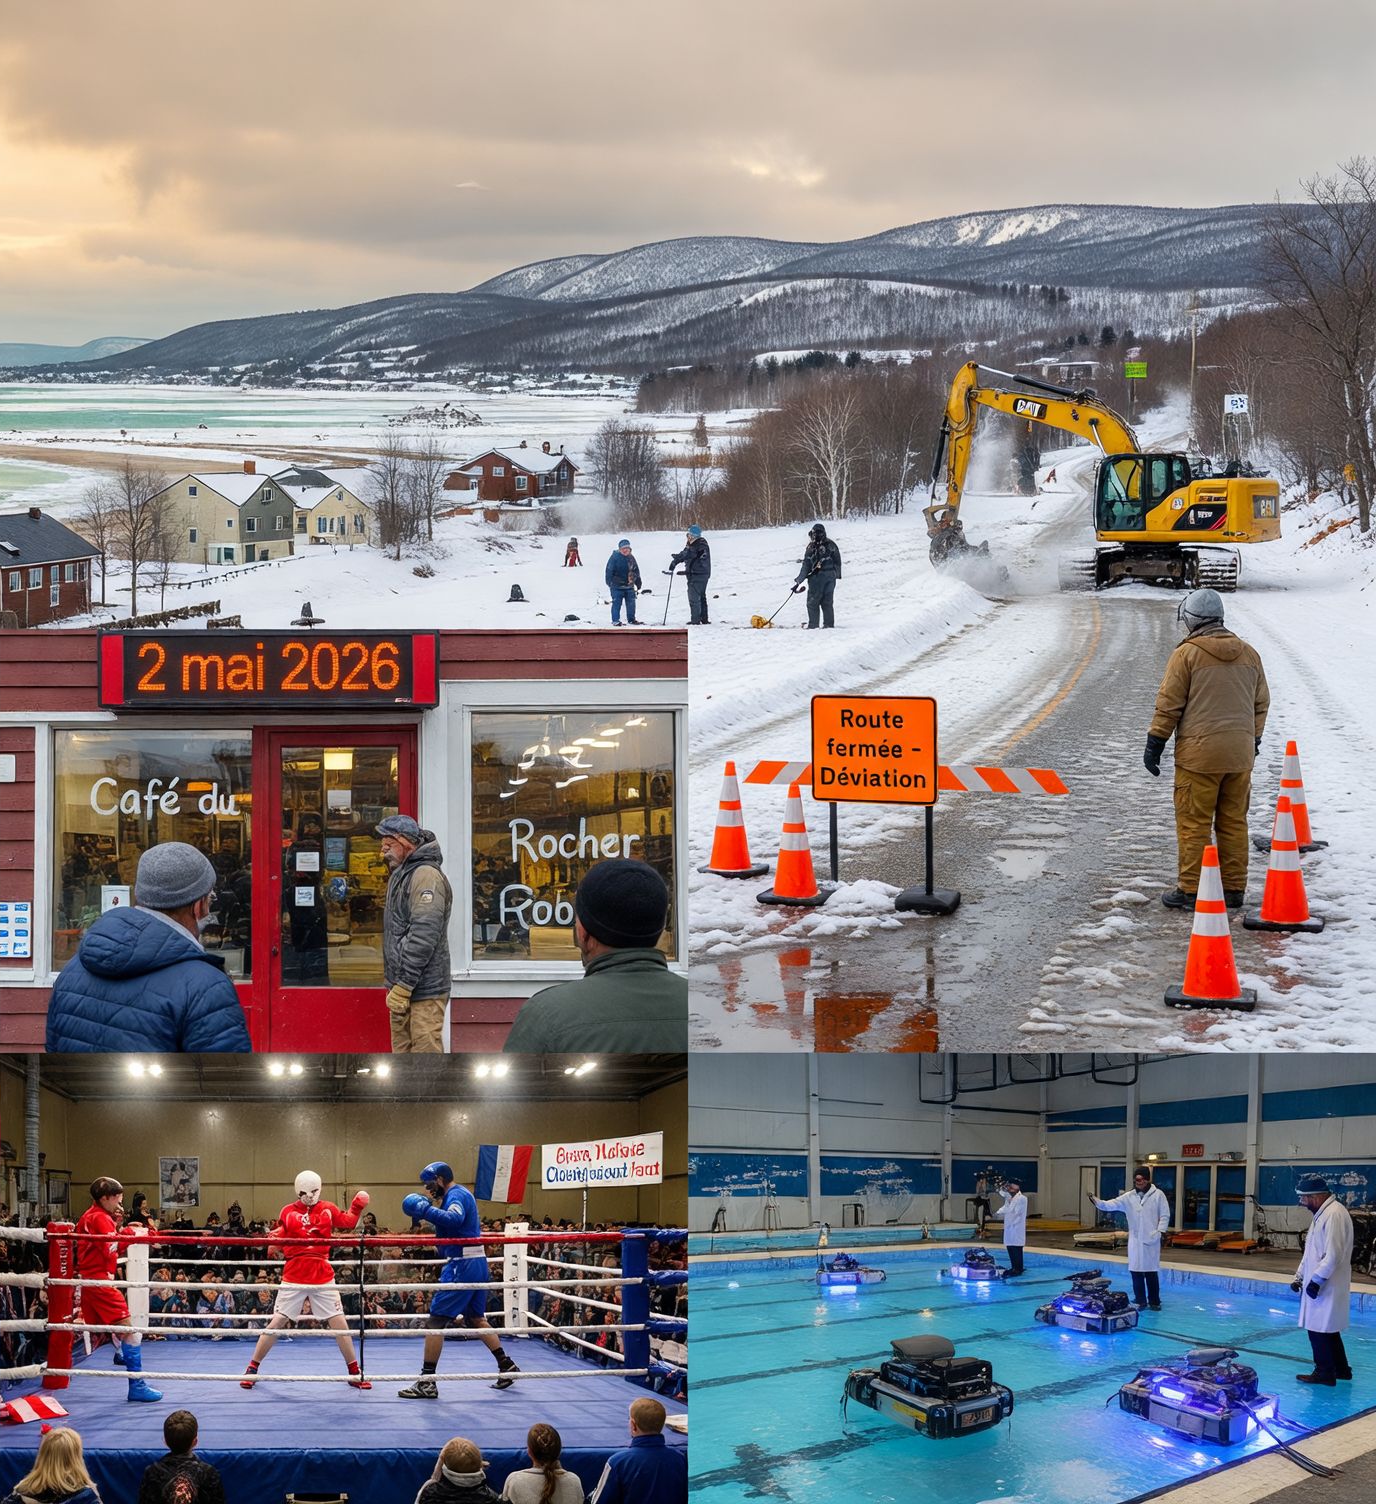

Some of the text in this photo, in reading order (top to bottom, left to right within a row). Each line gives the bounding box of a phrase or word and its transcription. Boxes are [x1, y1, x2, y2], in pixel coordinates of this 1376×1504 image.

[137, 642, 400, 691] 2 mai 2026
[840, 709, 904, 729] Route
[827, 738, 903, 758] fermée
[820, 767, 926, 788] Déviation
[89, 776, 241, 821] Café du
[508, 817, 641, 863] Rocher
